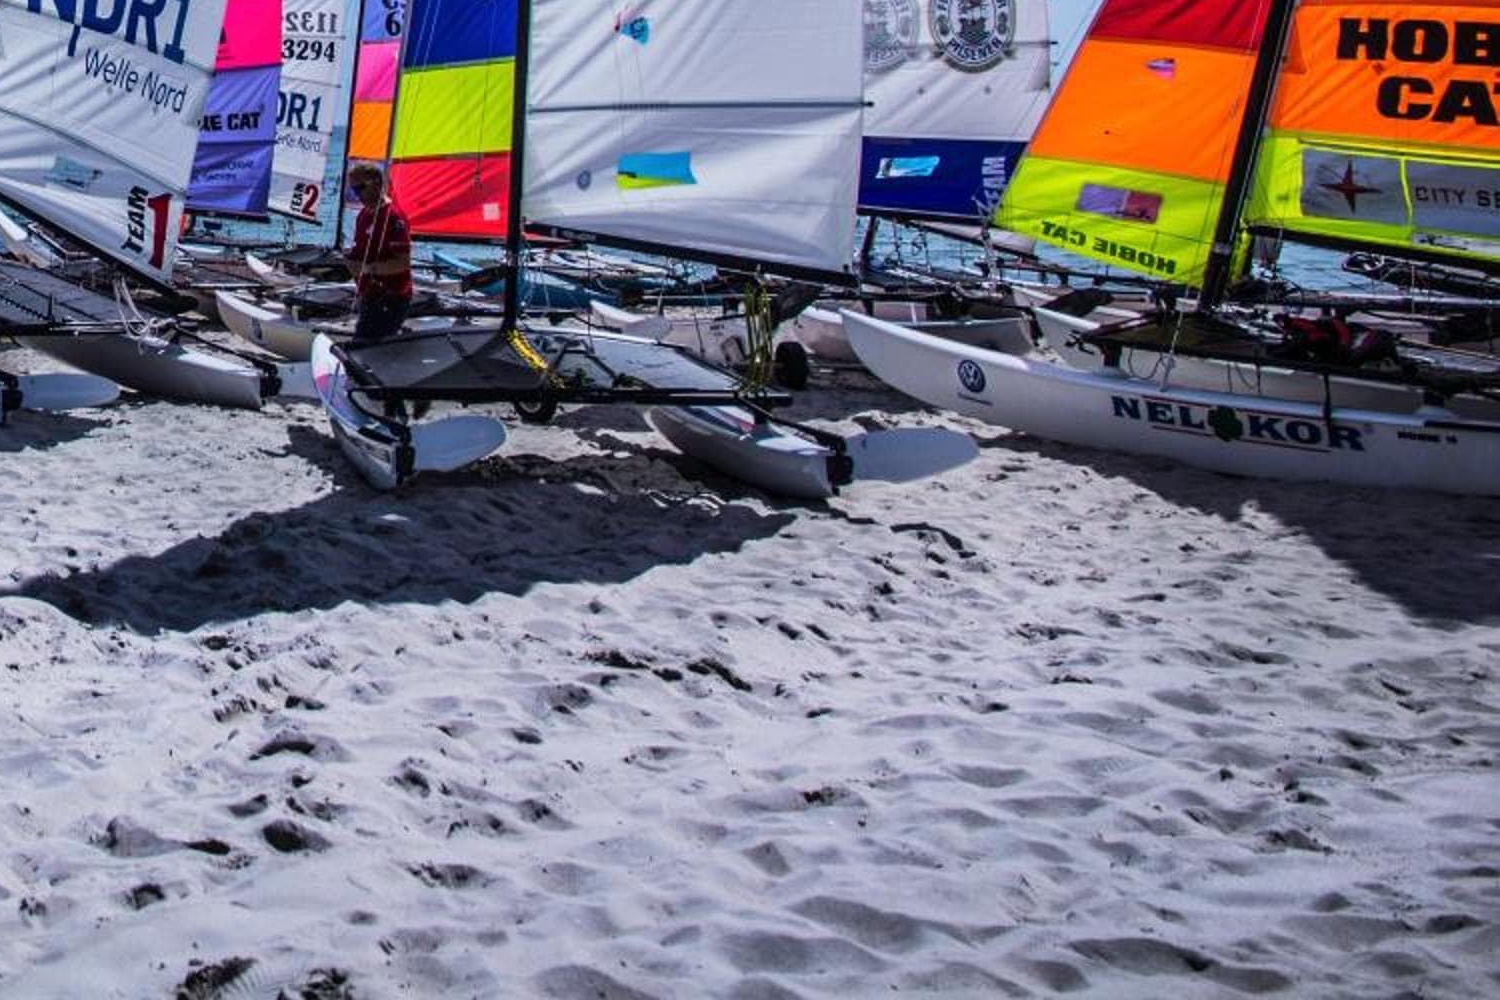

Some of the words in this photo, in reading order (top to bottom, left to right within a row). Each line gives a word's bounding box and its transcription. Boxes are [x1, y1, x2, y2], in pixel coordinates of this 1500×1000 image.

[1336, 18, 1500, 67] HOB
[85, 48, 138, 93] Welle
[145, 72, 188, 113] Nord
[1376, 75, 1500, 126] CA
[227, 111, 261, 131] CAT
[302, 184, 318, 217] 2
[1415, 186, 1466, 206] CITY
[122, 186, 149, 253] TEAM
[148, 192, 173, 270] 1
